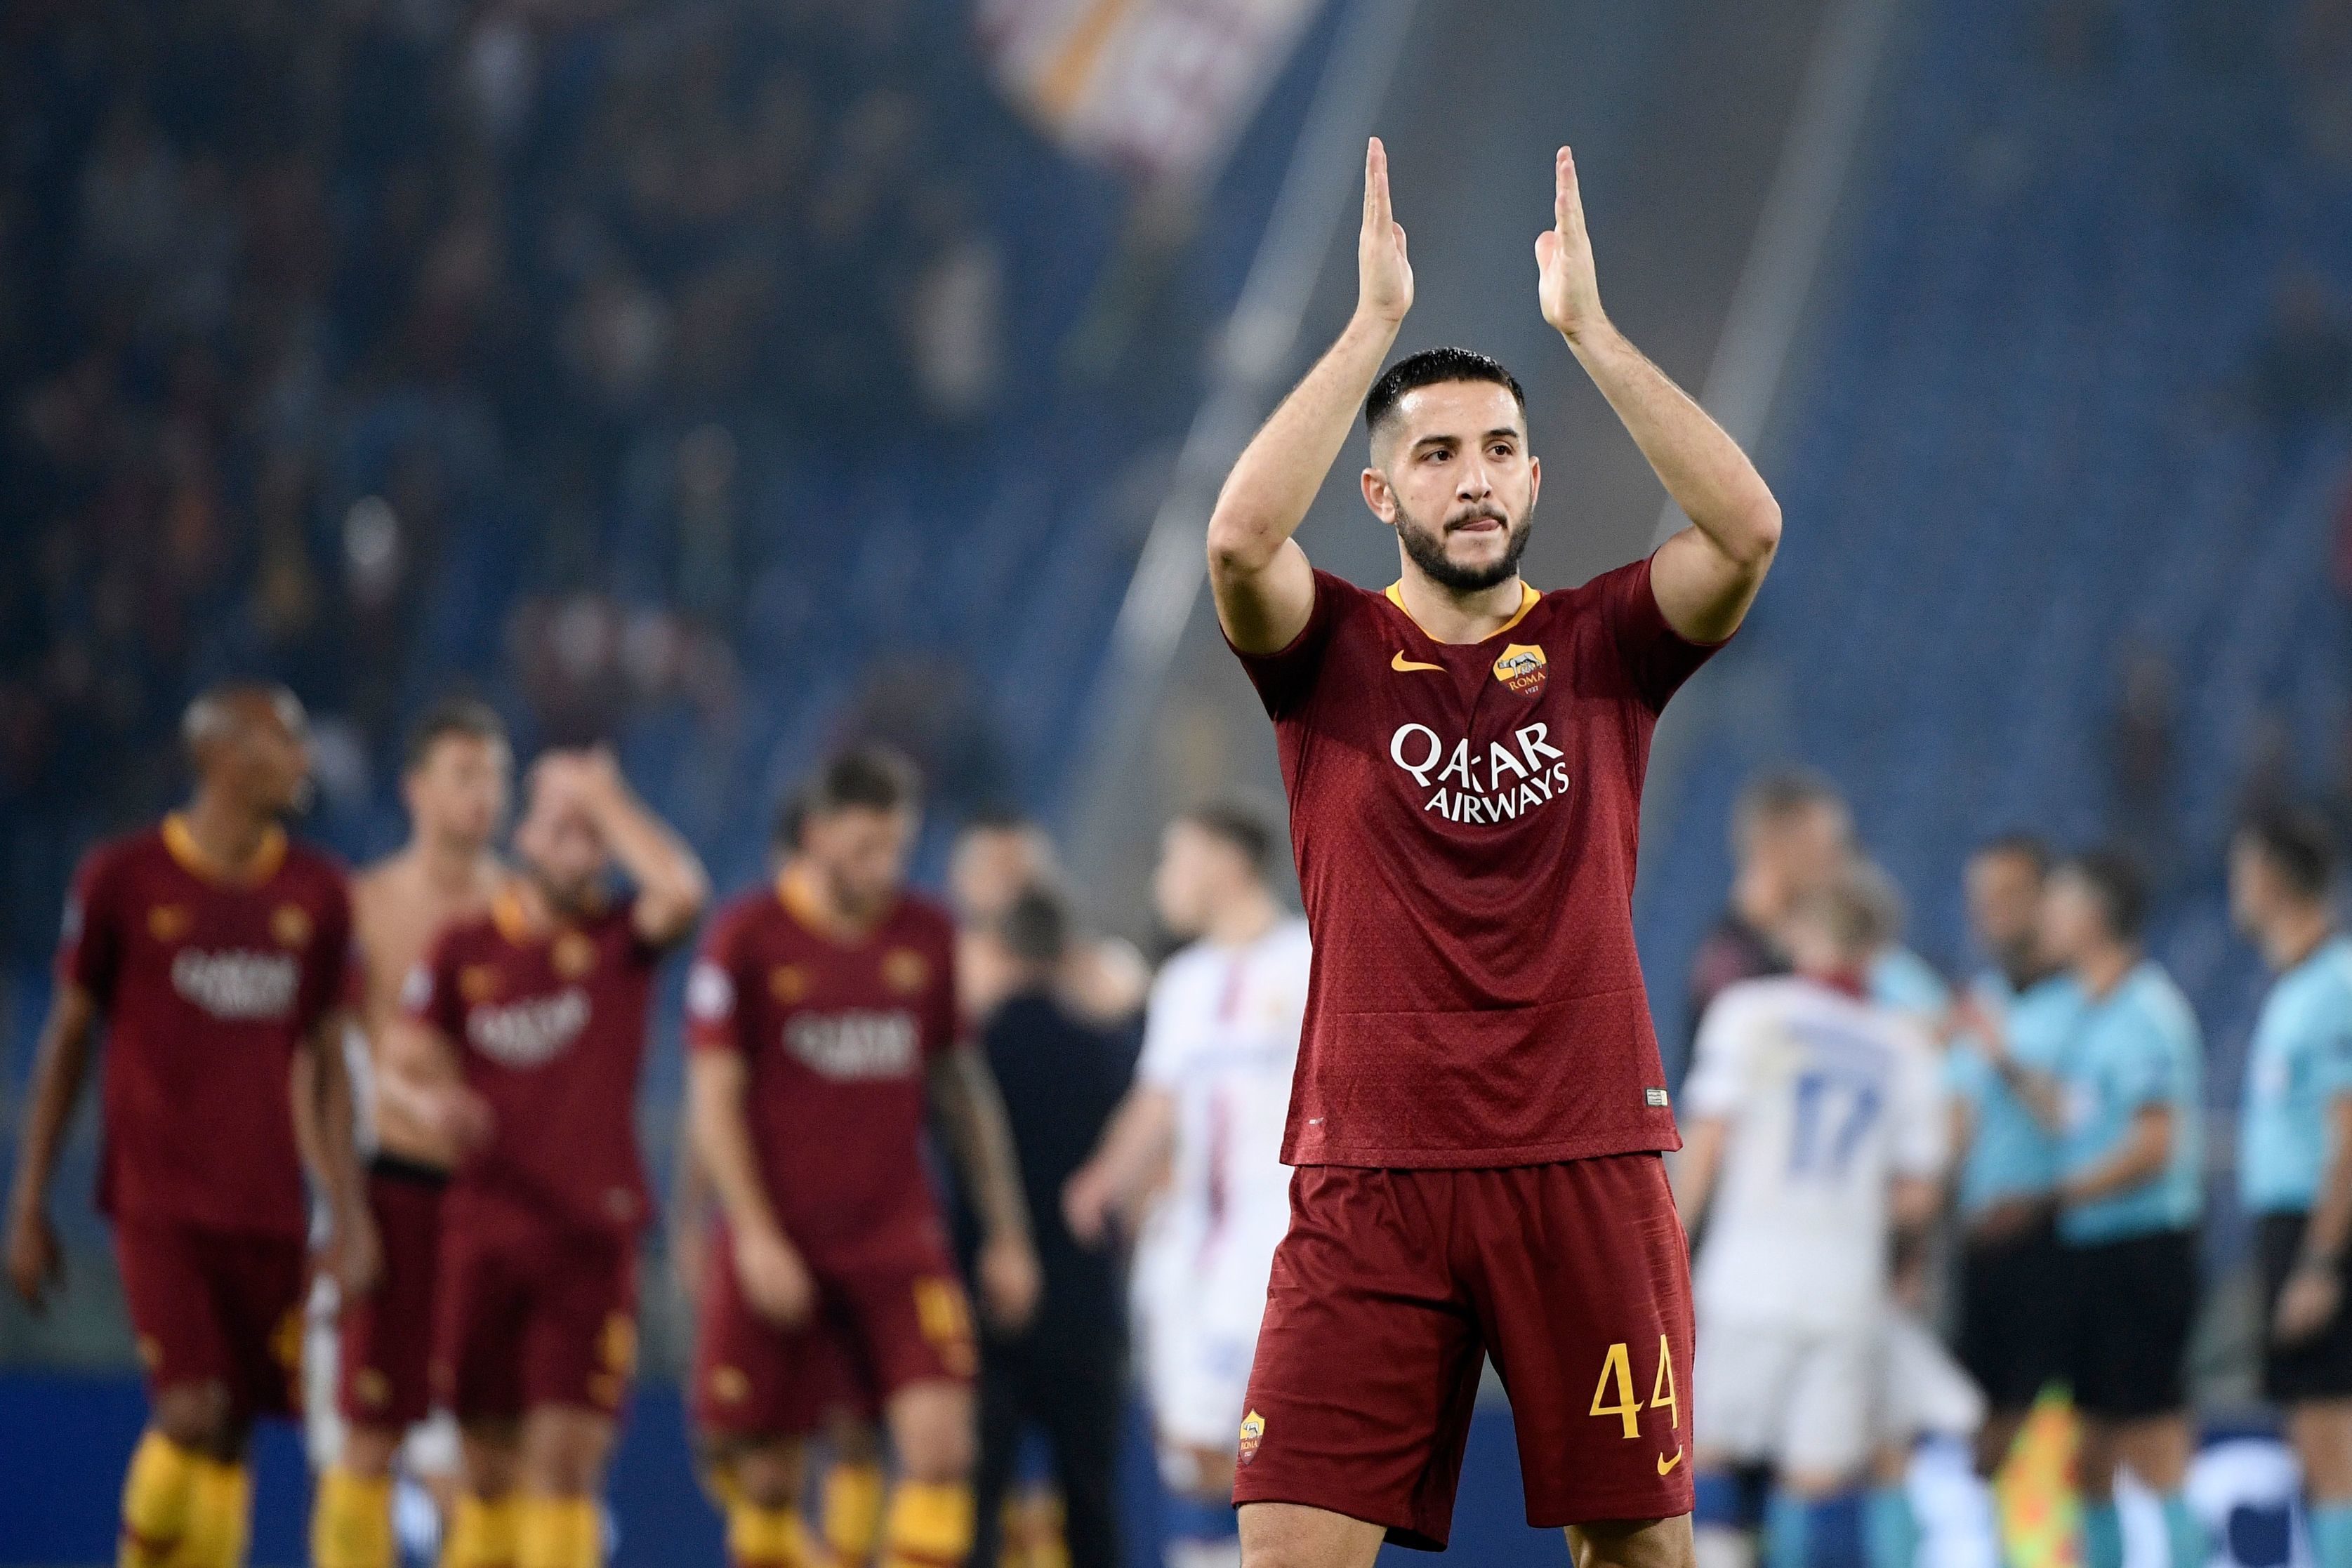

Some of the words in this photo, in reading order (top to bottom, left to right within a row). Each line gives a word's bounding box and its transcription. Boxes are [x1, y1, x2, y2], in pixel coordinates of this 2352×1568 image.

[1509, 671, 1547, 691] ROMA
[1424, 762, 1570, 824] AIRWAYS
[1589, 1334, 1678, 1439] 44
